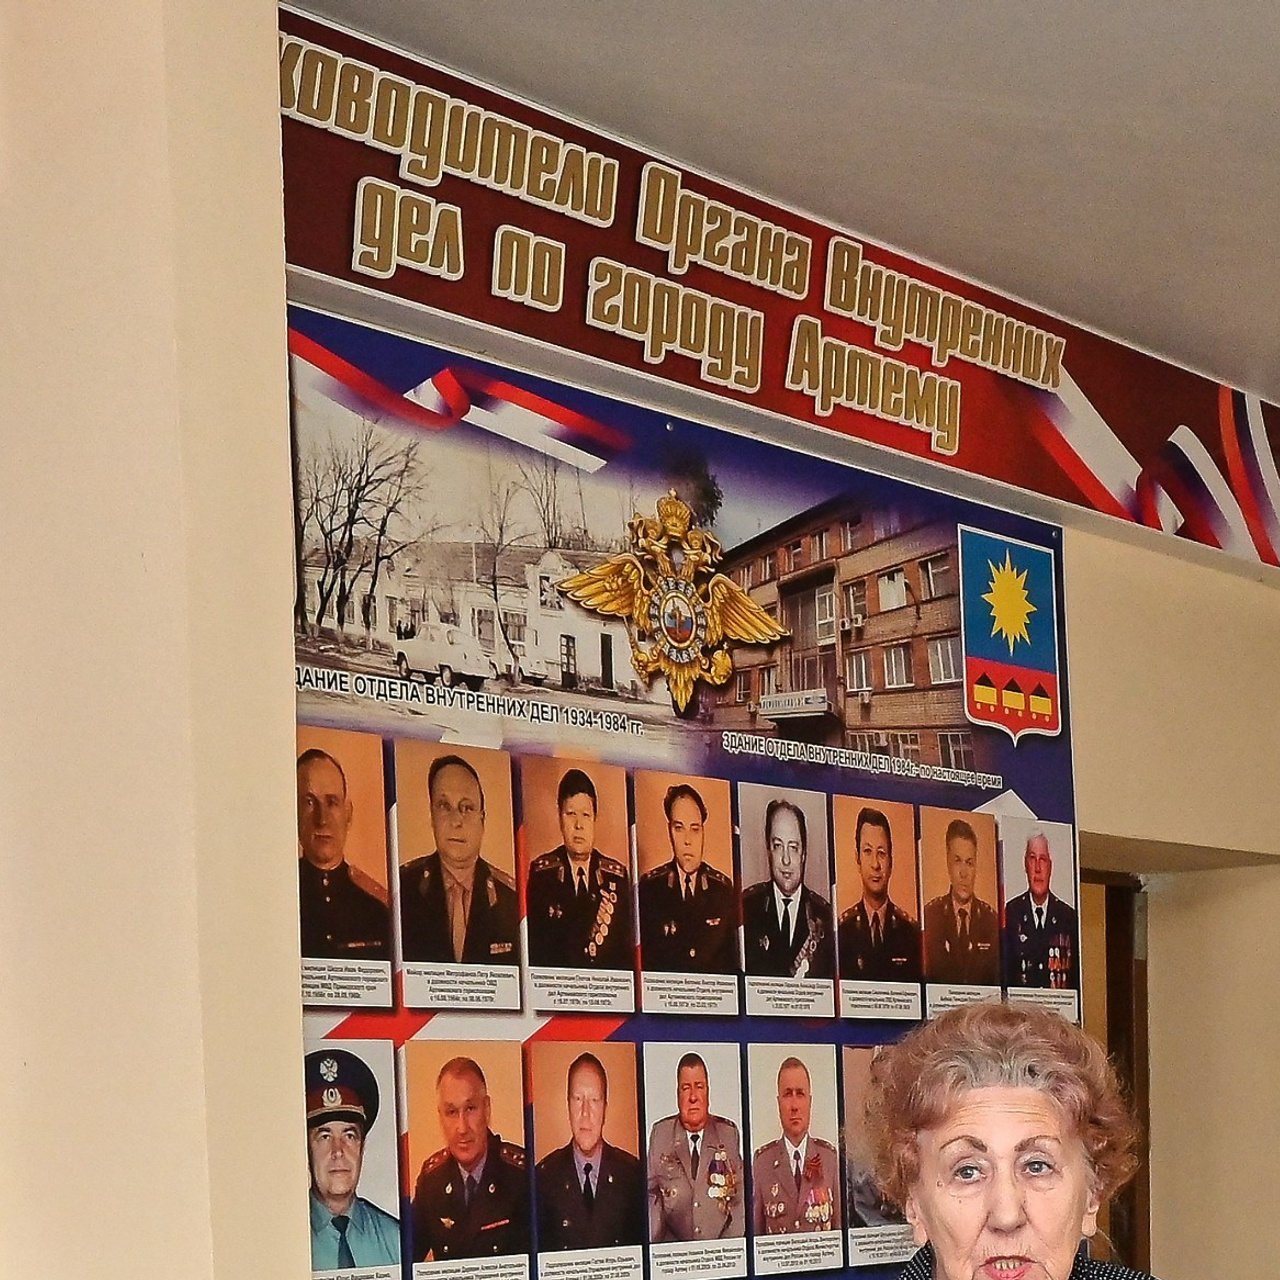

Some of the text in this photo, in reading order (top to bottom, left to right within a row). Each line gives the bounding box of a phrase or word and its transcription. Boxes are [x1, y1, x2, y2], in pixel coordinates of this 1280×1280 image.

[353, 176, 961, 455] дел по городу Артему
[639, 161, 811, 299] Органа
[825, 235, 1065, 388] Внутренних
[354, 676, 422, 703] ОТДЕЛА
[425, 688, 526, 719] ВНУТРЕННИХ
[529, 703, 559, 723] ДЕЛ
[562, 705, 627, 733] 1934-1984
[629, 719, 645, 736] гг.
[722, 731, 765, 756] ЗДАНИЕ
[766, 739, 807, 761] ОТДЕЛА
[808, 744, 871, 769] ВНУТРЕННИХ
[872, 755, 891, 773] ДЕЛ
[933, 767, 975, 786] настоящее
[977, 773, 1002, 789] время
